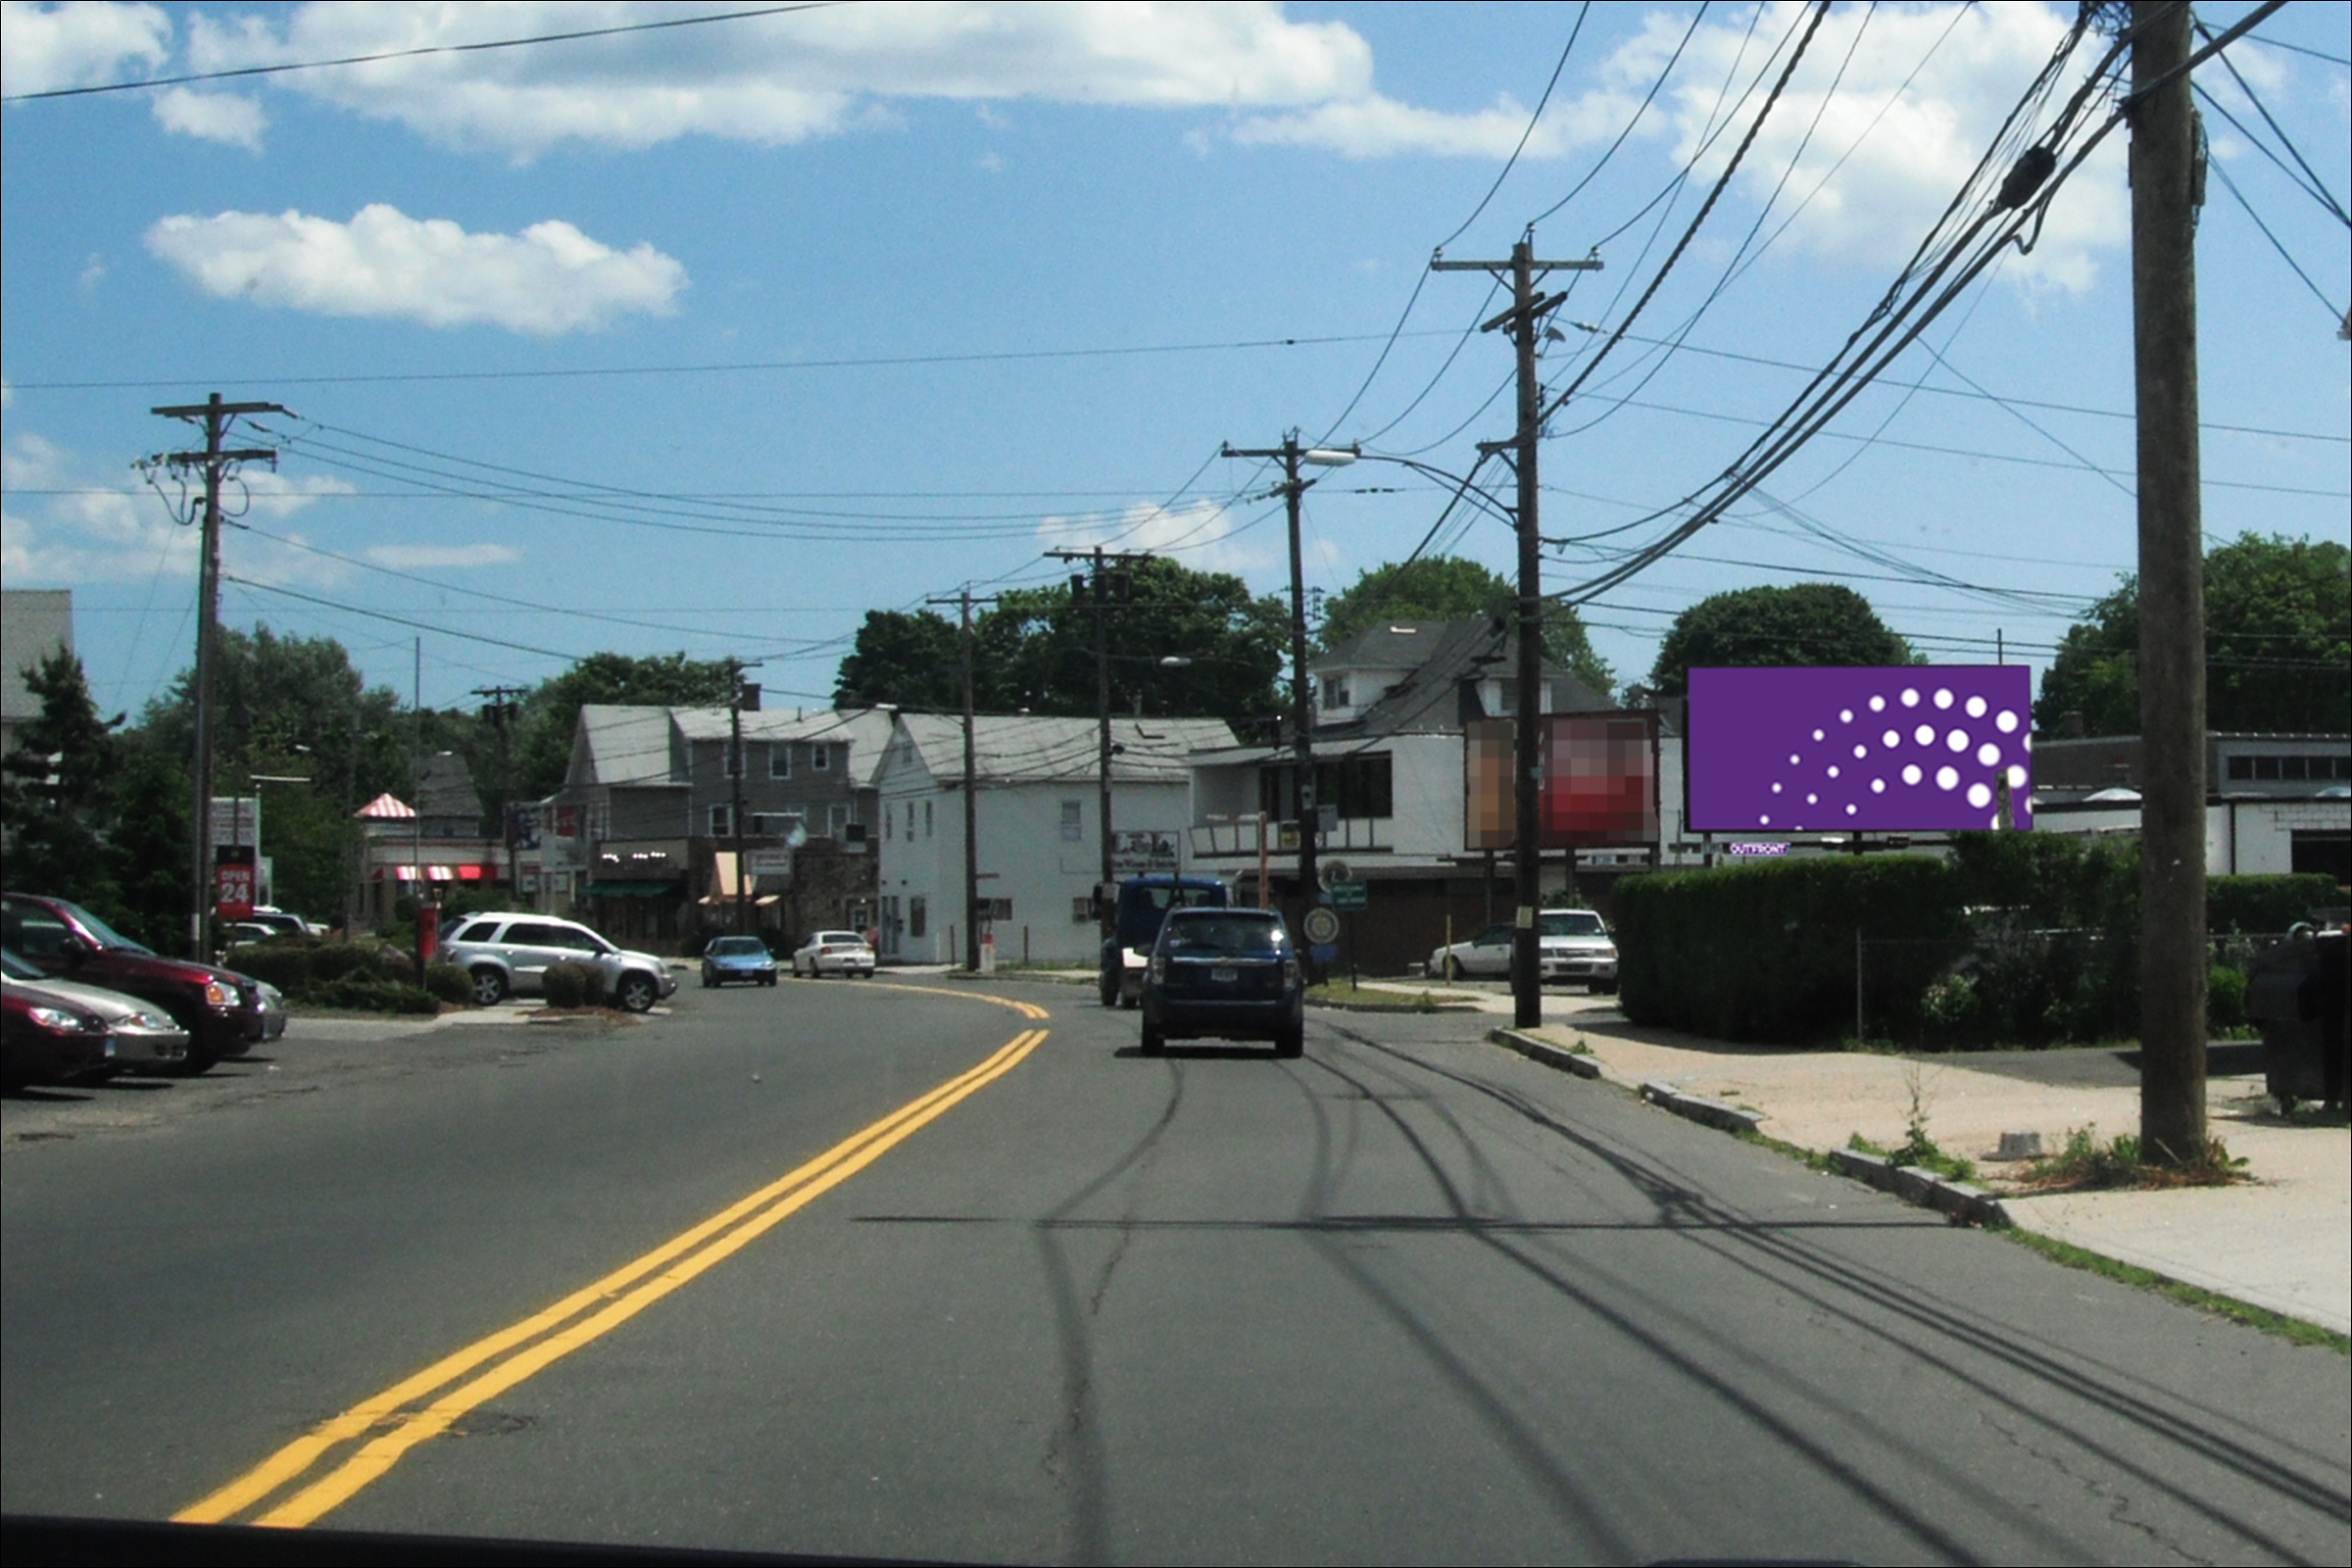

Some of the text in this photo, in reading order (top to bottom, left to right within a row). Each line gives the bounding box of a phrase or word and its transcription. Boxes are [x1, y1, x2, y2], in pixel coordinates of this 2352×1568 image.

[1730, 843, 1788, 855] OUTFRONT
[221, 870, 251, 881] OPEN
[220, 882, 250, 904] 24
